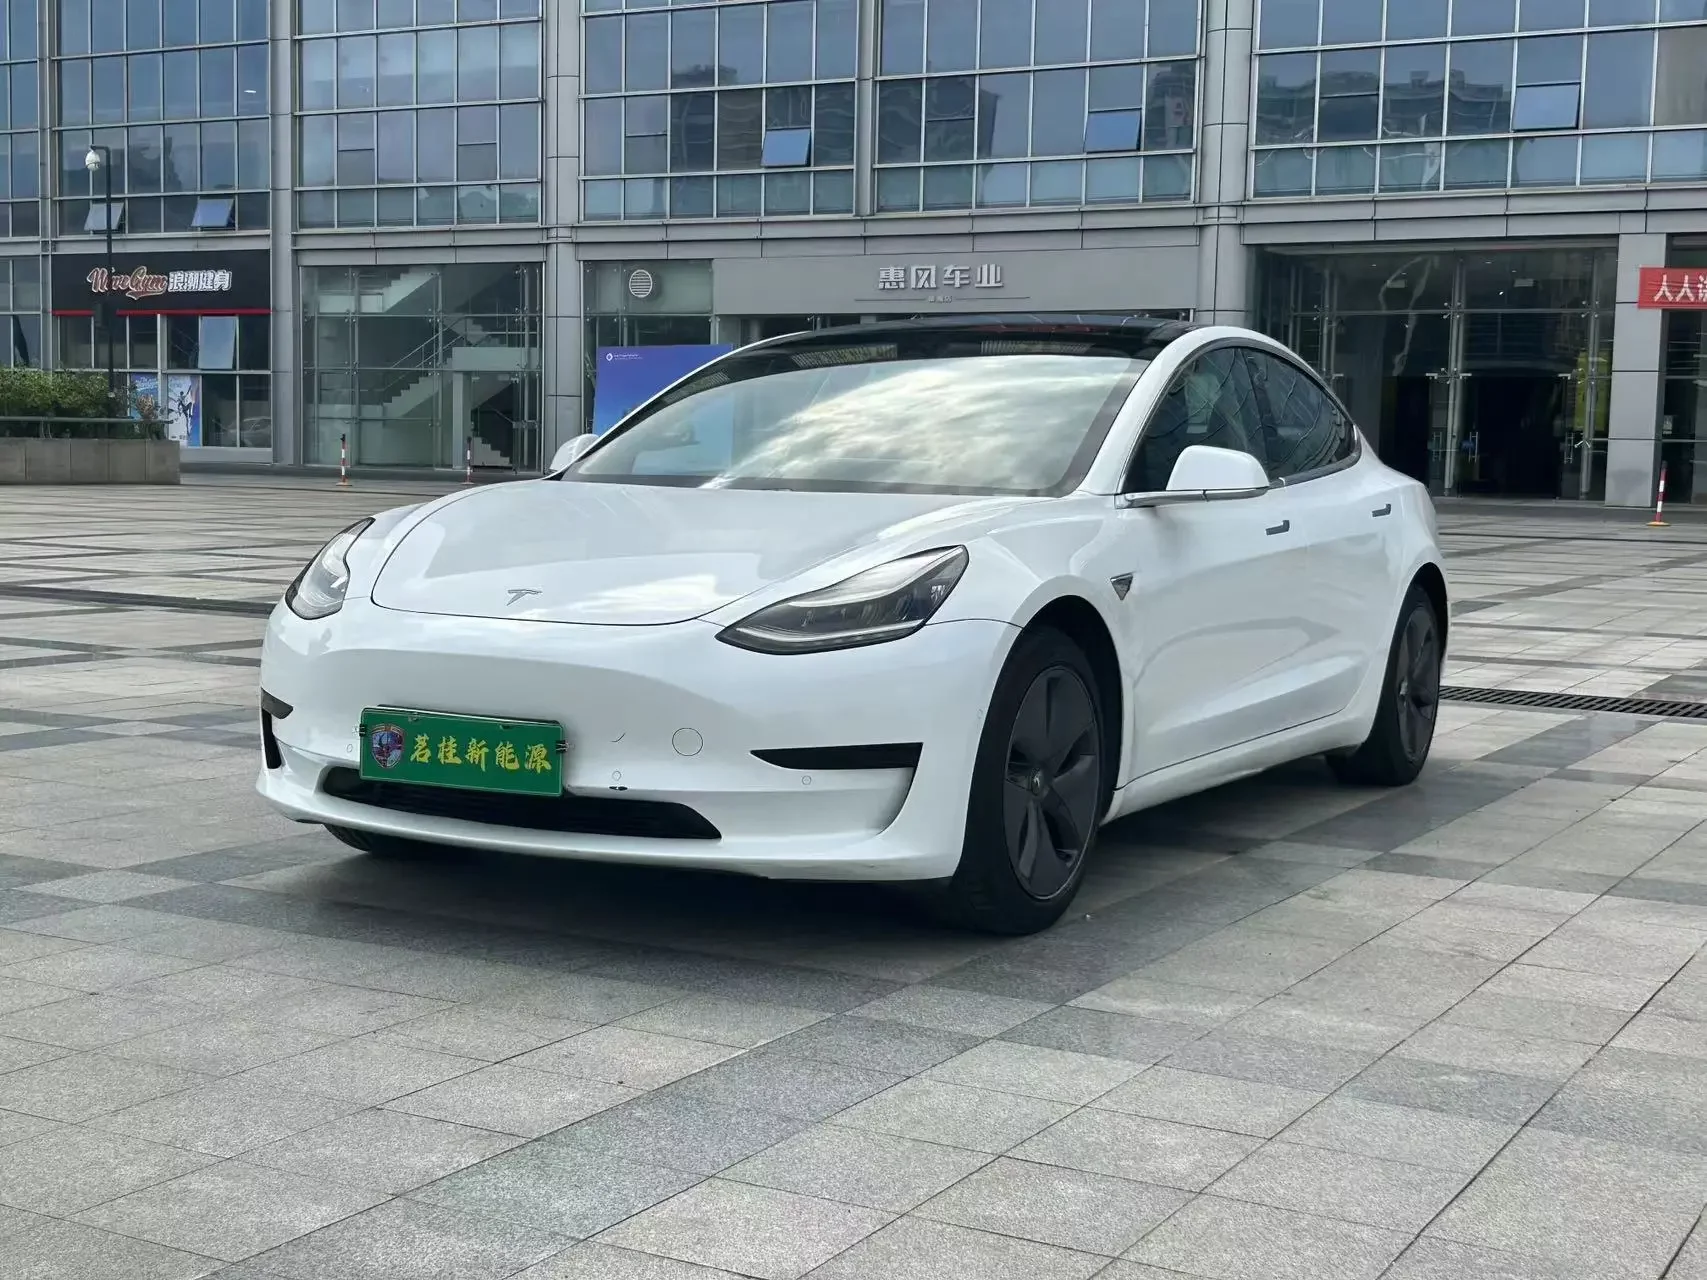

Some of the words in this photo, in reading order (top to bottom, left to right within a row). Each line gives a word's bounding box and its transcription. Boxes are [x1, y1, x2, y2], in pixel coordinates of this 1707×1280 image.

[168, 269, 232, 292] 浪潮健身
[878, 264, 1004, 290] 惠风车业
